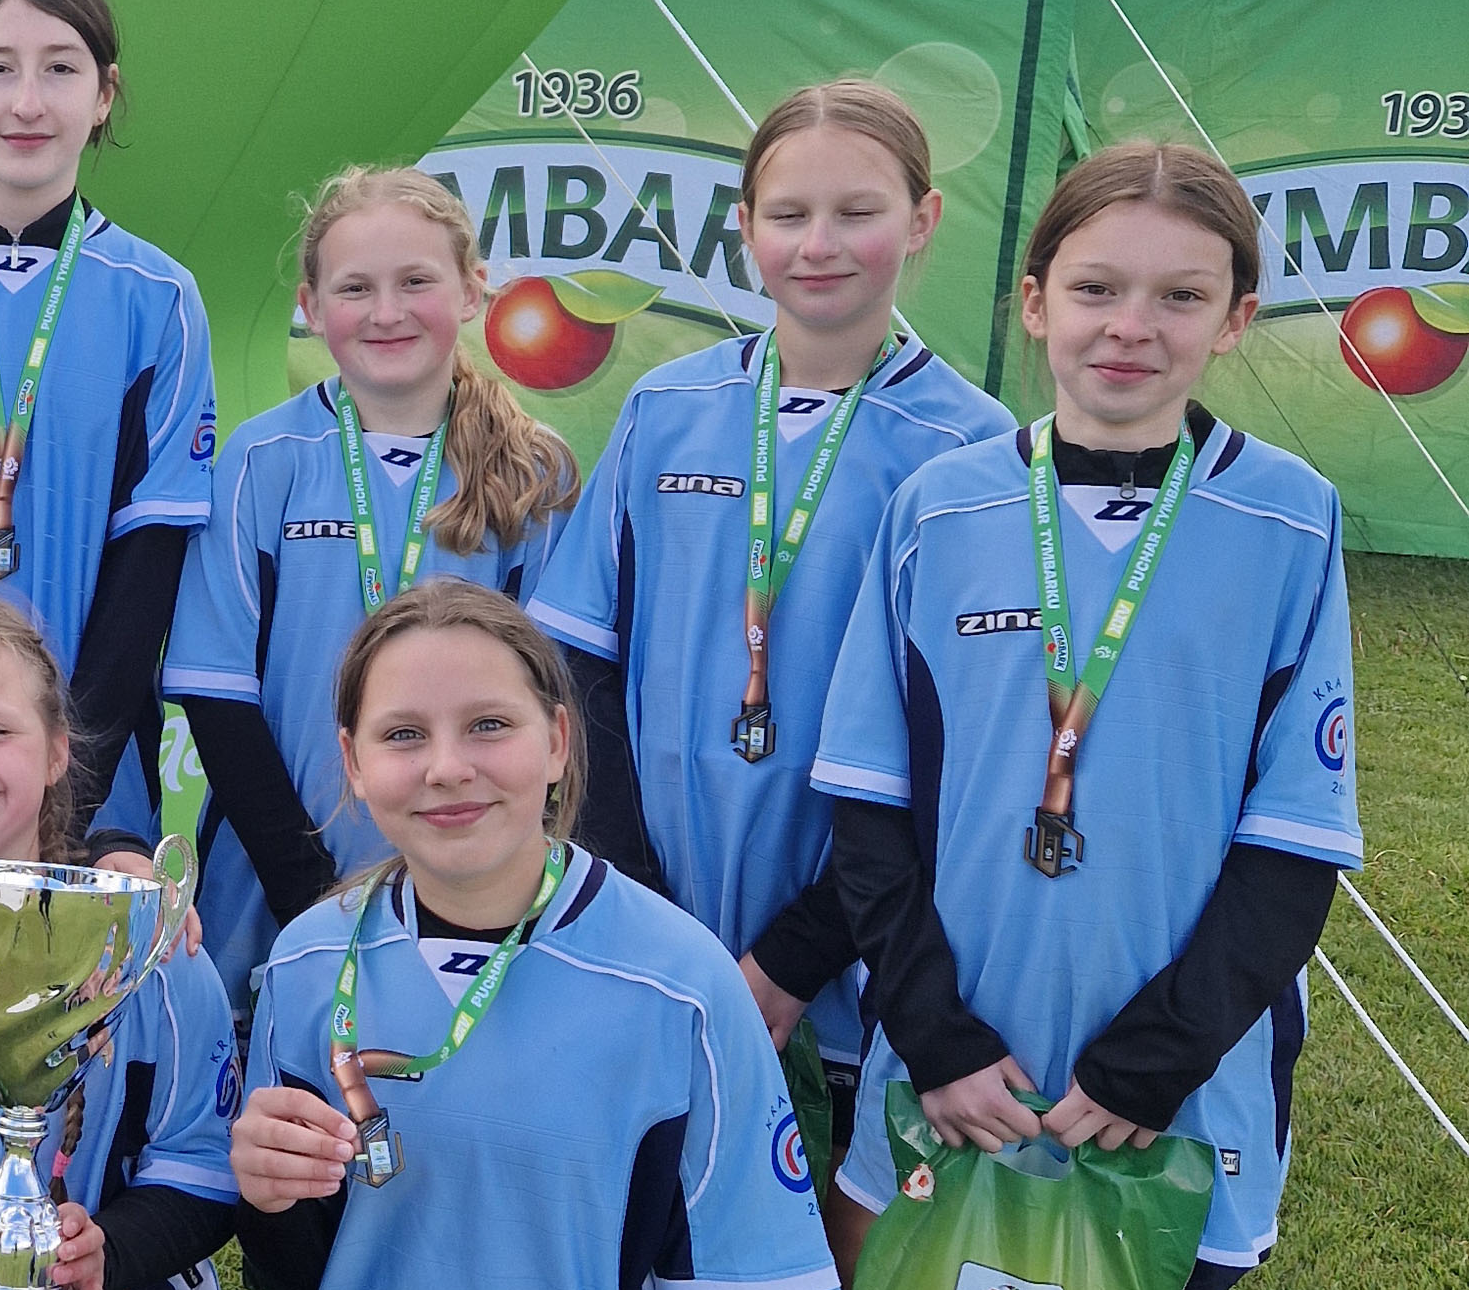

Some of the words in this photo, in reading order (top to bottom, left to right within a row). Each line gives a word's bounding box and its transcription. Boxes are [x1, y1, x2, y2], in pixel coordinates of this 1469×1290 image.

[513, 68, 642, 119] 1936
[1381, 90, 1469, 138] 193
[435, 165, 759, 298] MBAR
[1253, 182, 1469, 277] MB
[41, 285, 63, 330] PUCHAR
[56, 224, 81, 282] TYMBARKU
[758, 362, 774, 425] TYMBARKU
[341, 405, 360, 464] TYMBARKU
[756, 428, 770, 483] PUCHAR
[351, 467, 369, 516] PUCHAR
[657, 475, 745, 497] zina
[802, 447, 831, 501] PUCHAR
[1034, 466, 1050, 525] PUCHAR
[413, 486, 432, 534] PUCHAR
[1127, 532, 1162, 591] PUCHAR
[1153, 454, 1190, 528] TYMBARKU
[1040, 528, 1061, 610] TYMBARKU
[471, 950, 509, 1007] PUCHAR
